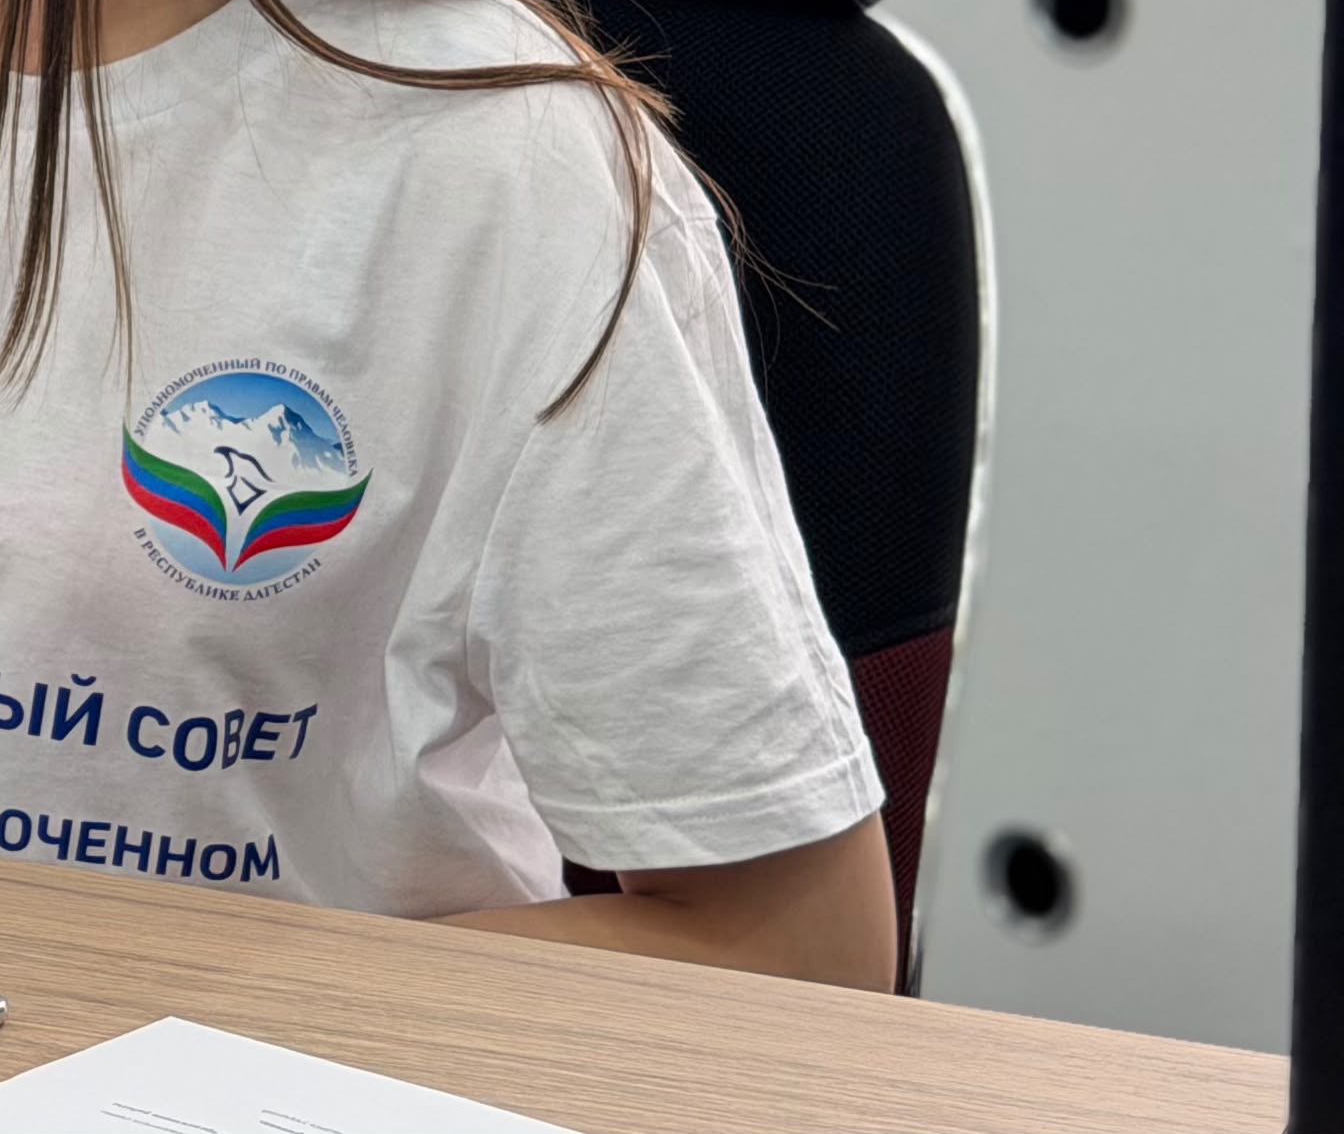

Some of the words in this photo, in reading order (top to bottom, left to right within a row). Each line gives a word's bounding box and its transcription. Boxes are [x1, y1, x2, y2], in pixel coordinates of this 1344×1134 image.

[133, 358, 262, 437] УПОЛНОМОЧЕННЫЙ
[265, 361, 287, 376] ПО
[289, 368, 334, 409] ПРАВАМ
[332, 405, 359, 478] ЧЕЛОВЕКА
[140, 540, 241, 602] РЕСПУБЛИКЕ
[243, 558, 322, 602] ДАГЕСТАН
[127, 704, 318, 771] СОВЕТ
